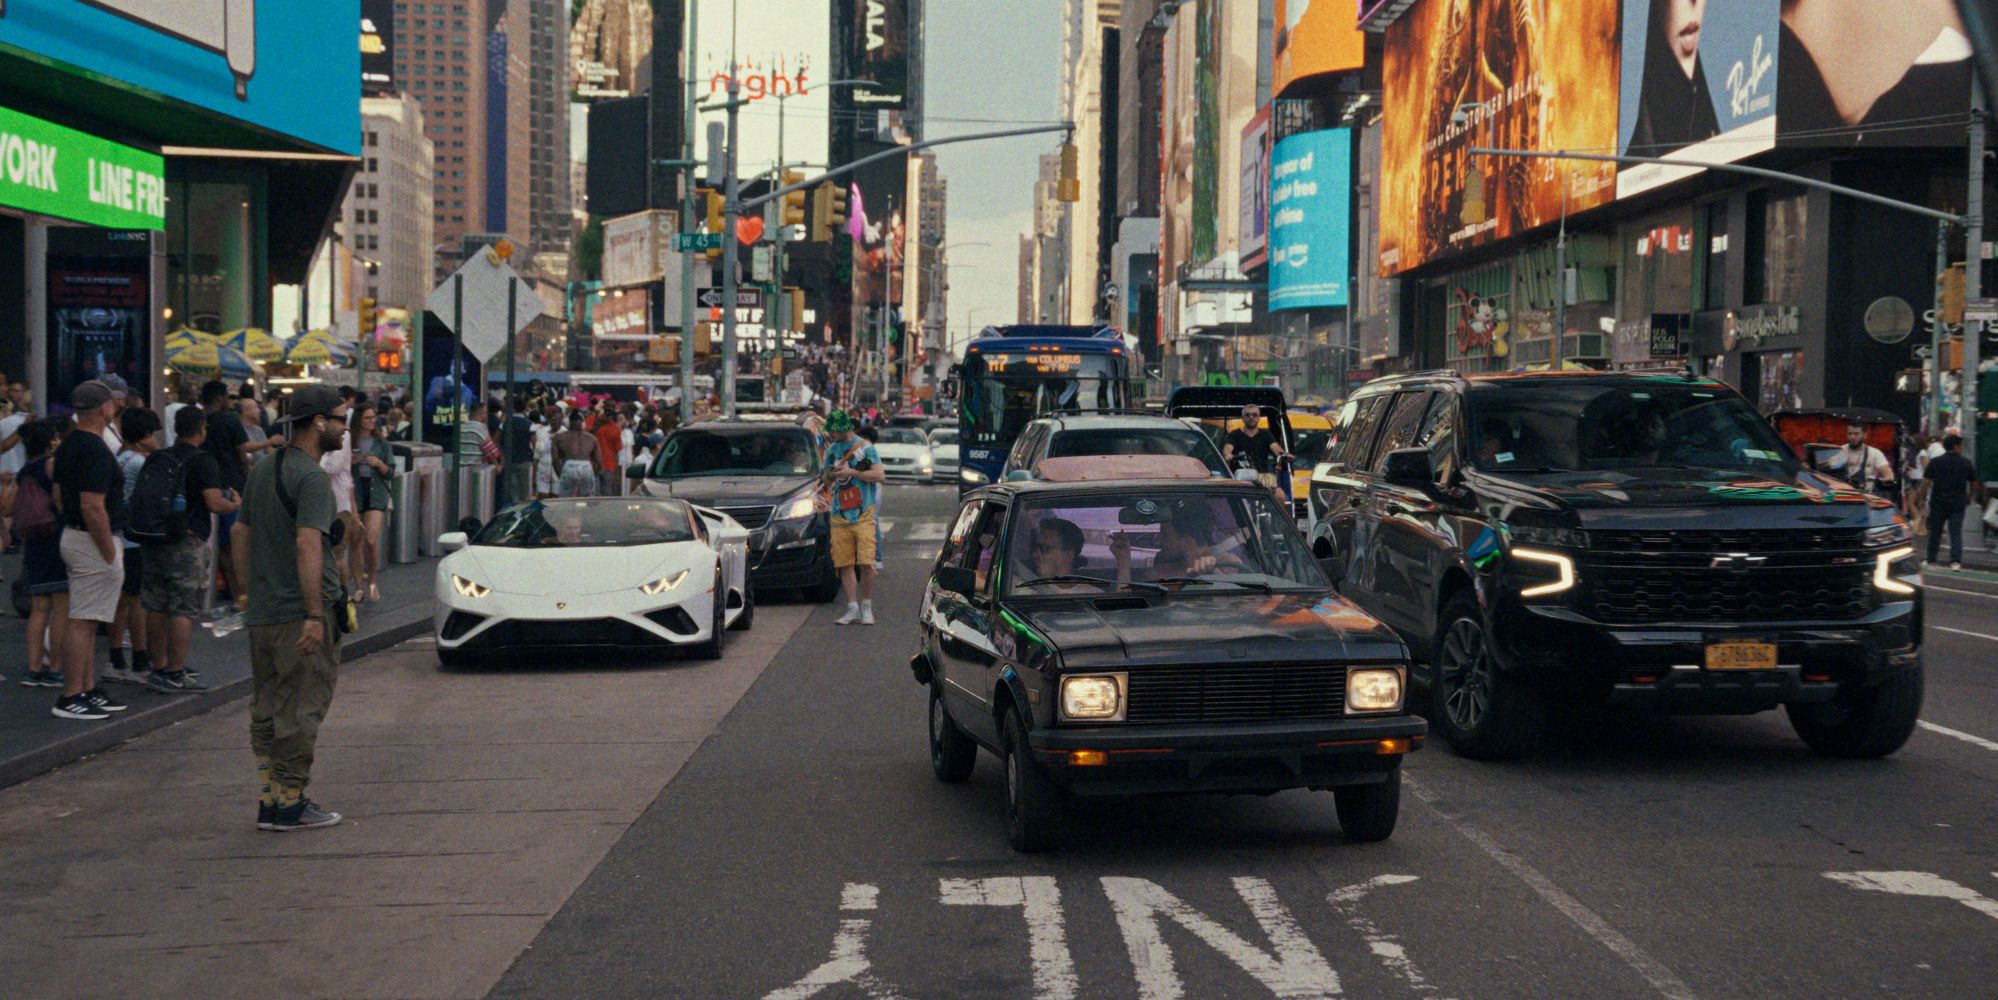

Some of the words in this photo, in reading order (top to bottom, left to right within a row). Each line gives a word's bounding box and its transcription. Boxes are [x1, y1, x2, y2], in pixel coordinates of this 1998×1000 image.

[88, 157, 132, 210] LINE
[107, 232, 146, 241] LinkNYC
[682, 235, 691, 247] W
[696, 235, 709, 247] 45
[1039, 354, 1081, 365] COLUMBUS
